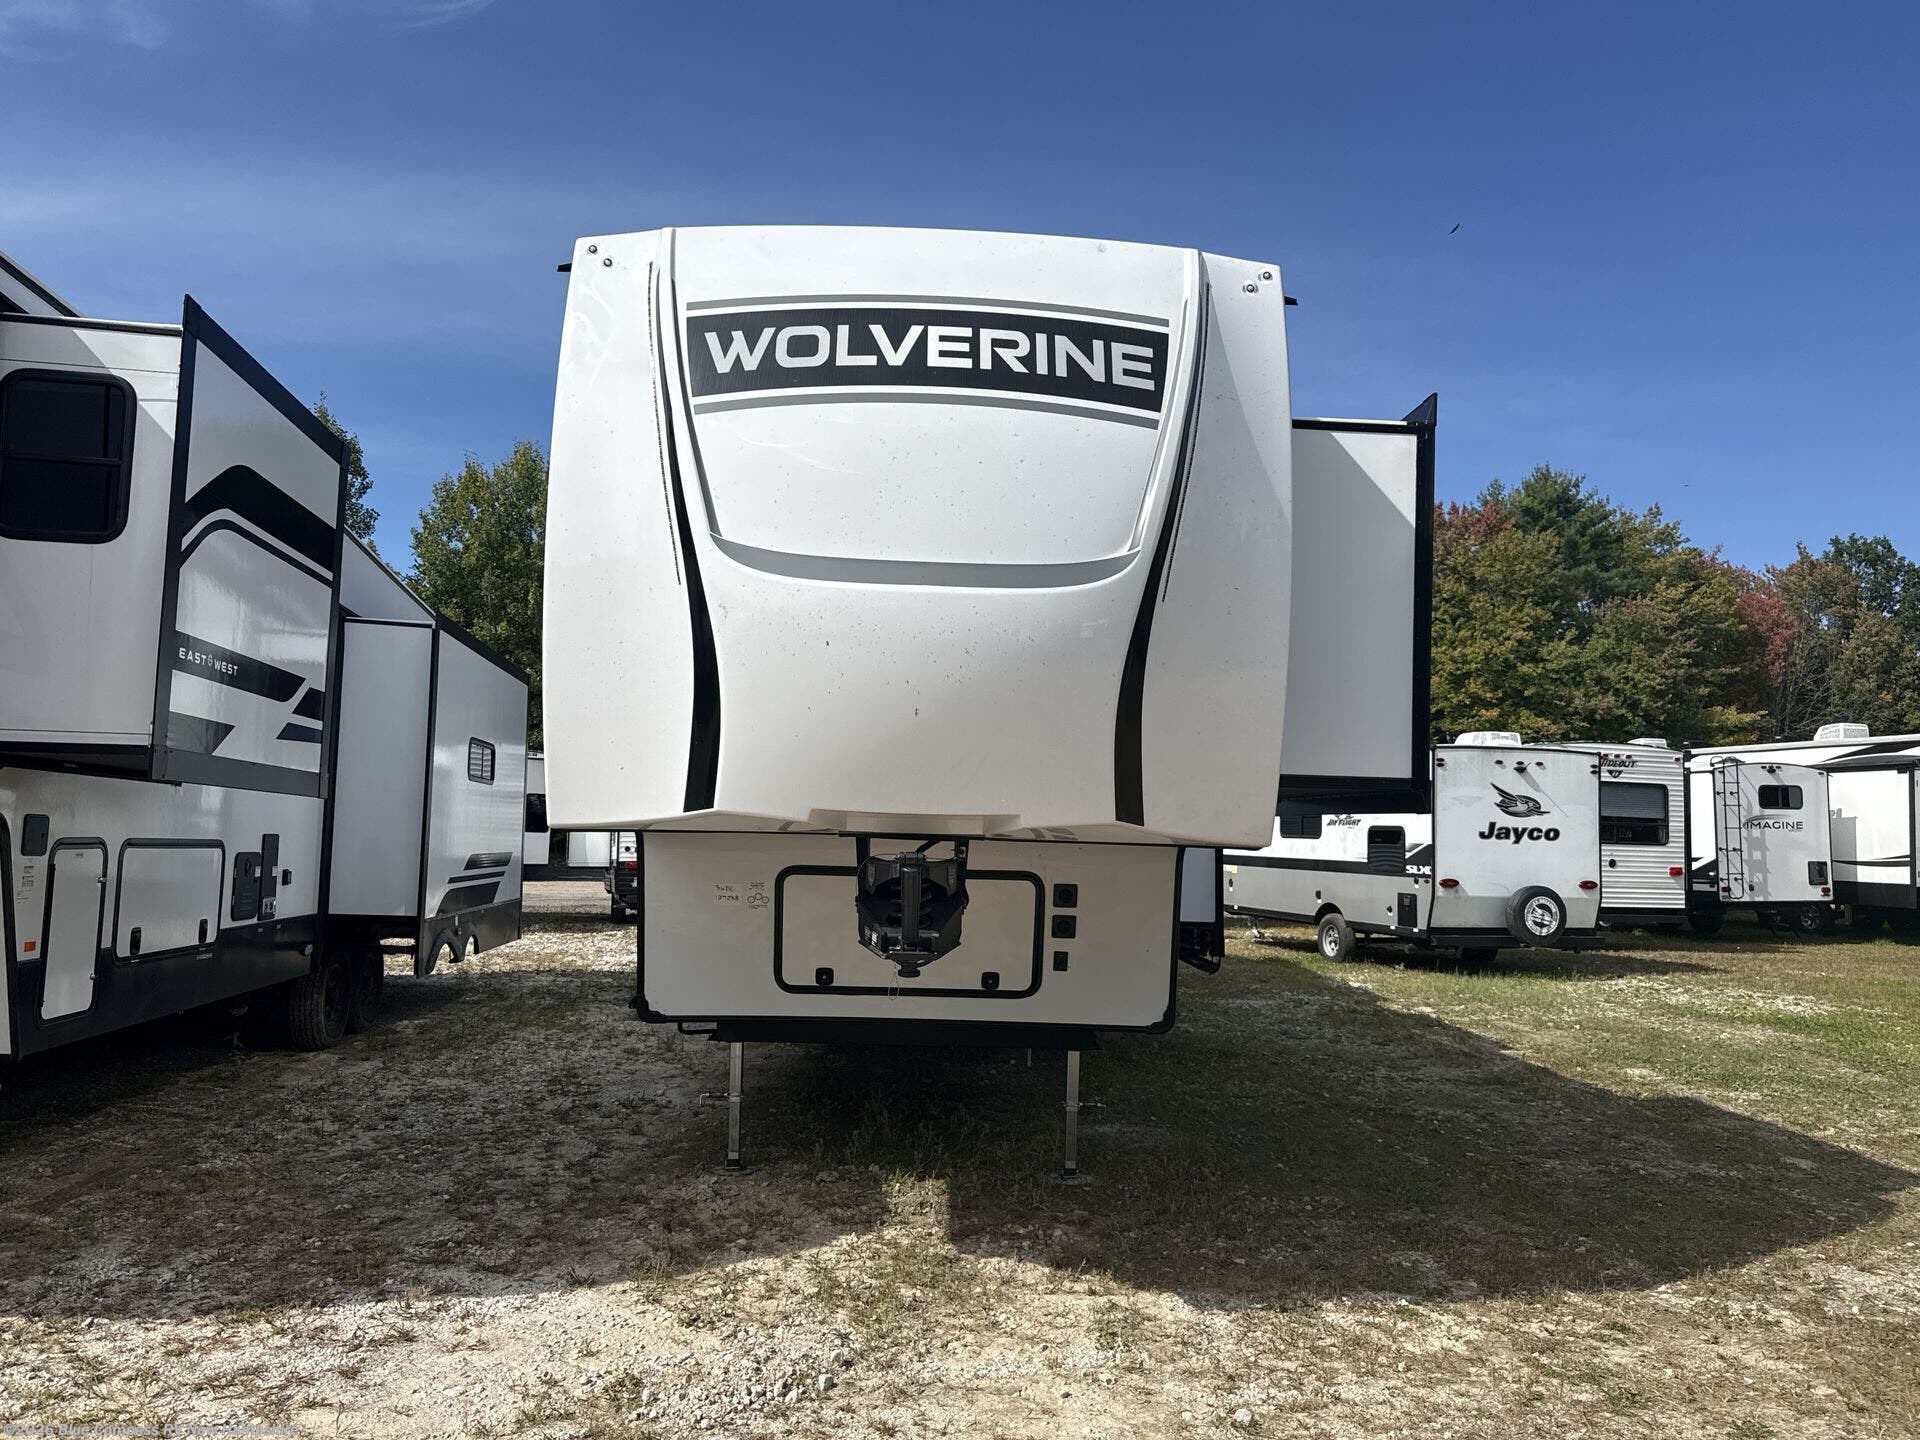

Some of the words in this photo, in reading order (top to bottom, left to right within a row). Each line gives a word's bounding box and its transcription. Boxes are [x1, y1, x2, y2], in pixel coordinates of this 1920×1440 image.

[704, 324, 1155, 391] WOLVERINE
[179, 647, 206, 665] EAST
[214, 659, 238, 676] WEST
[1478, 821, 1560, 844] Jayco
[1746, 821, 1804, 830] IMAGINE
